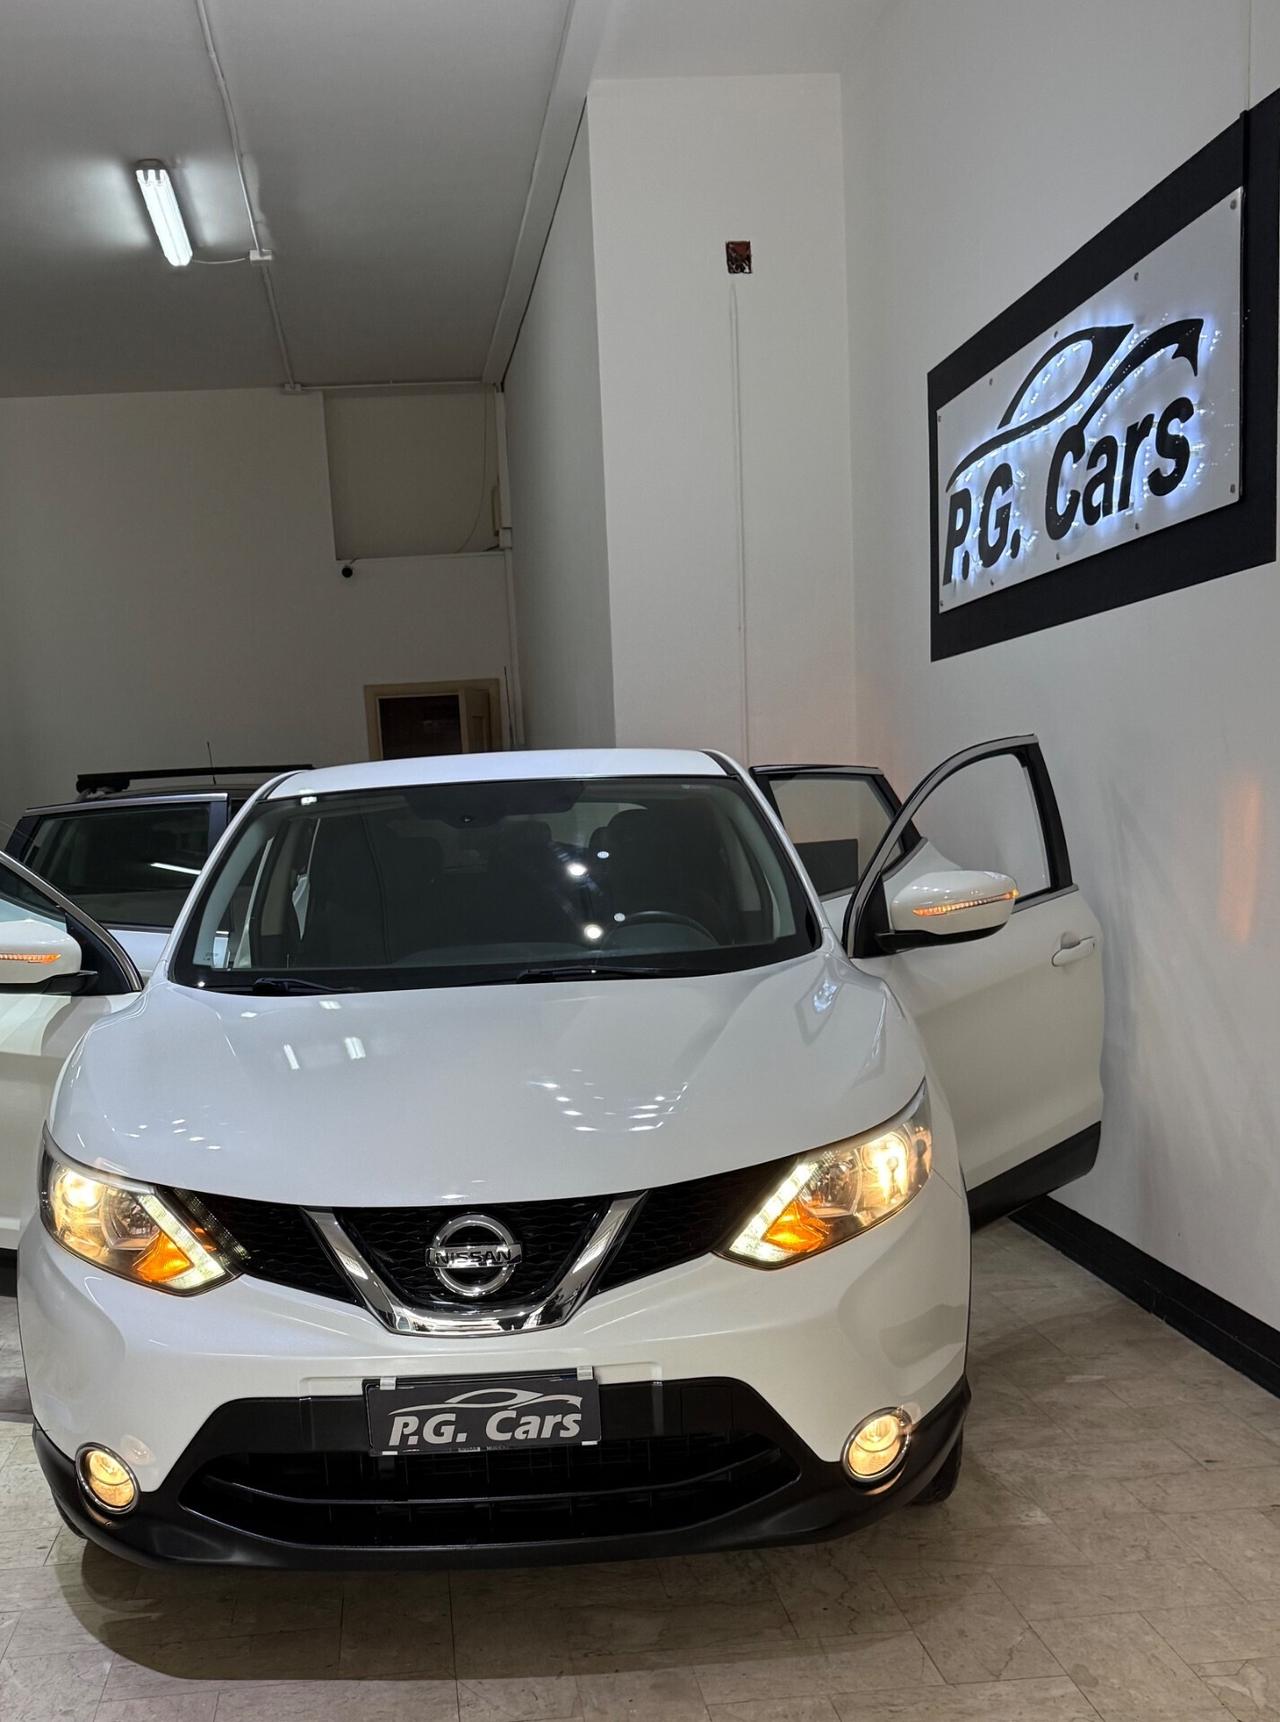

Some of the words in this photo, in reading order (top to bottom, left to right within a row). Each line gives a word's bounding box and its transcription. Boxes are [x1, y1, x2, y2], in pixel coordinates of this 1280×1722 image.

[942, 462, 1021, 586] P.G.
[1045, 396, 1194, 540] Cars
[435, 1249, 512, 1264] NISSAN
[388, 1413, 467, 1446] P.G.
[485, 1410, 582, 1441] Cars
